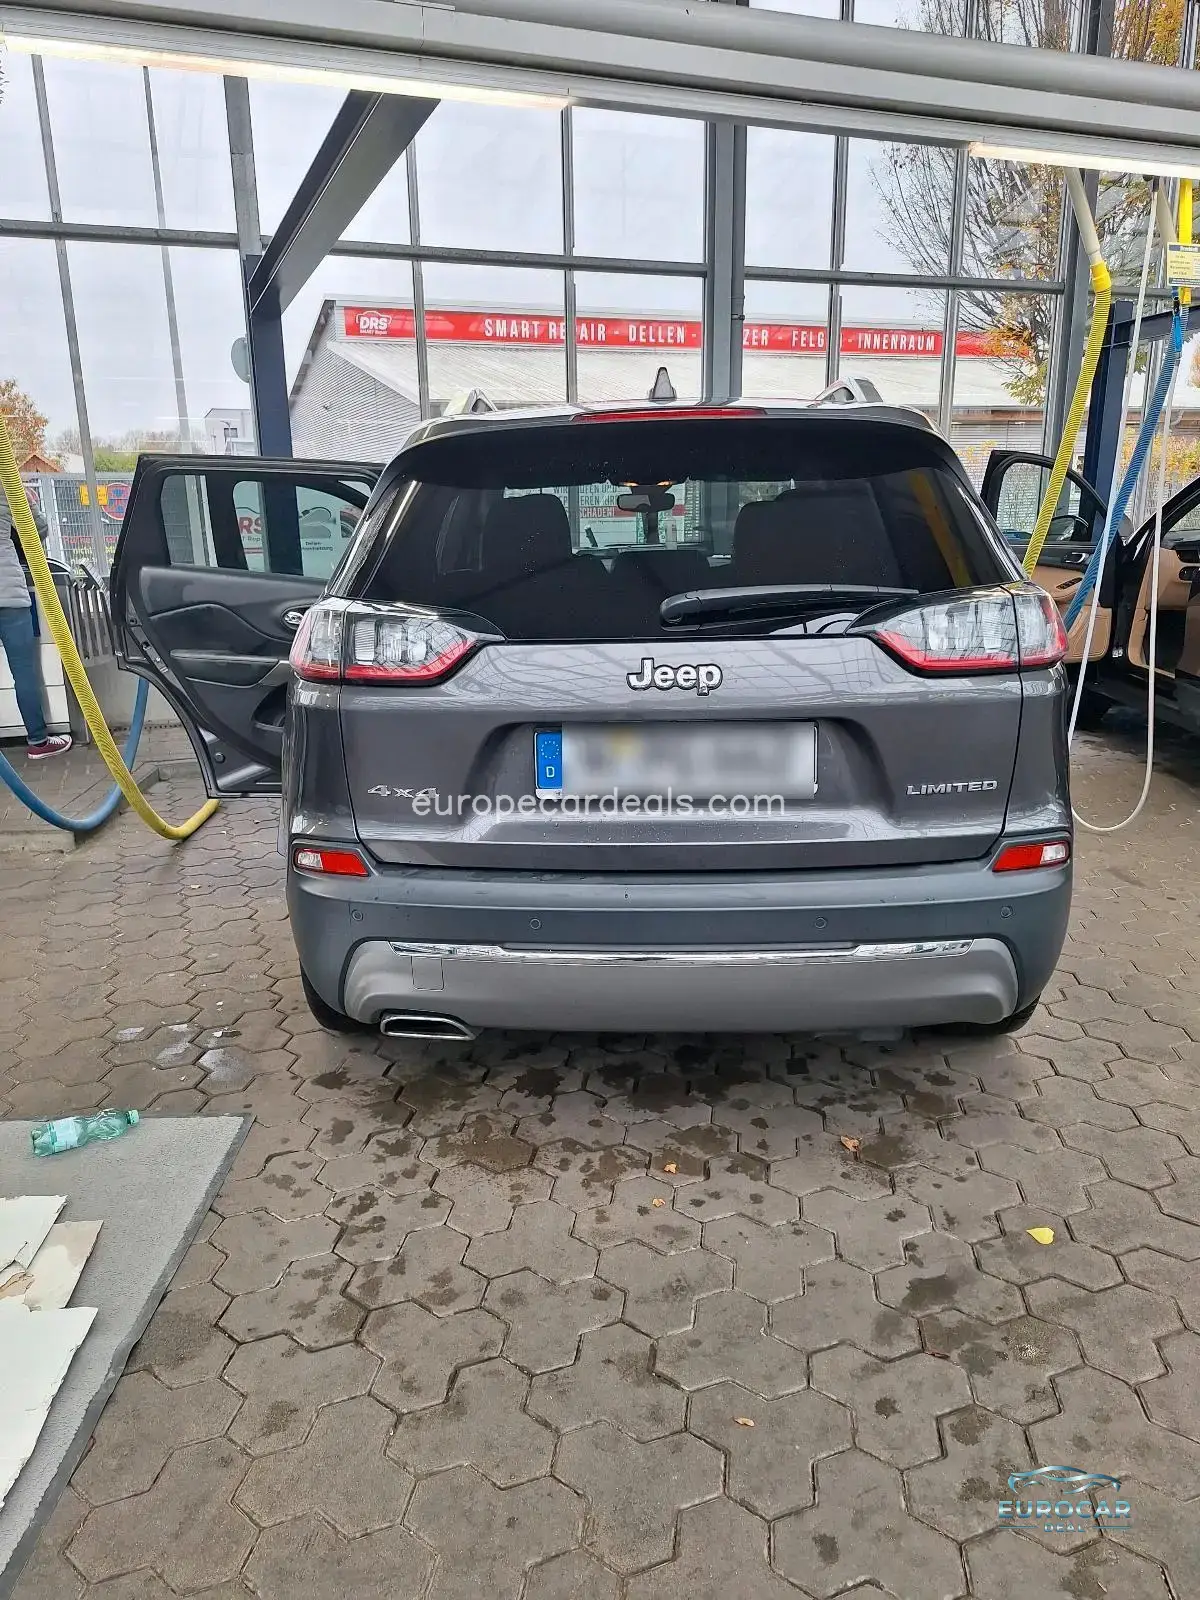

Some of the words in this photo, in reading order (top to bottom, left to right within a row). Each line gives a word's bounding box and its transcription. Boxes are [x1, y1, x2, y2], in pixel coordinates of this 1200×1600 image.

[360, 316, 388, 330] DRS
[484, 318, 540, 339] SMART
[548, 321, 606, 341] REAIR
[628, 324, 686, 344] DELLEN
[791, 329, 843, 349] FELG
[857, 331, 936, 352] INNENRAUM
[239, 516, 263, 534] RS
[626, 657, 723, 696] Jeep
[546, 766, 555, 778] D
[907, 780, 998, 795] LIMITED
